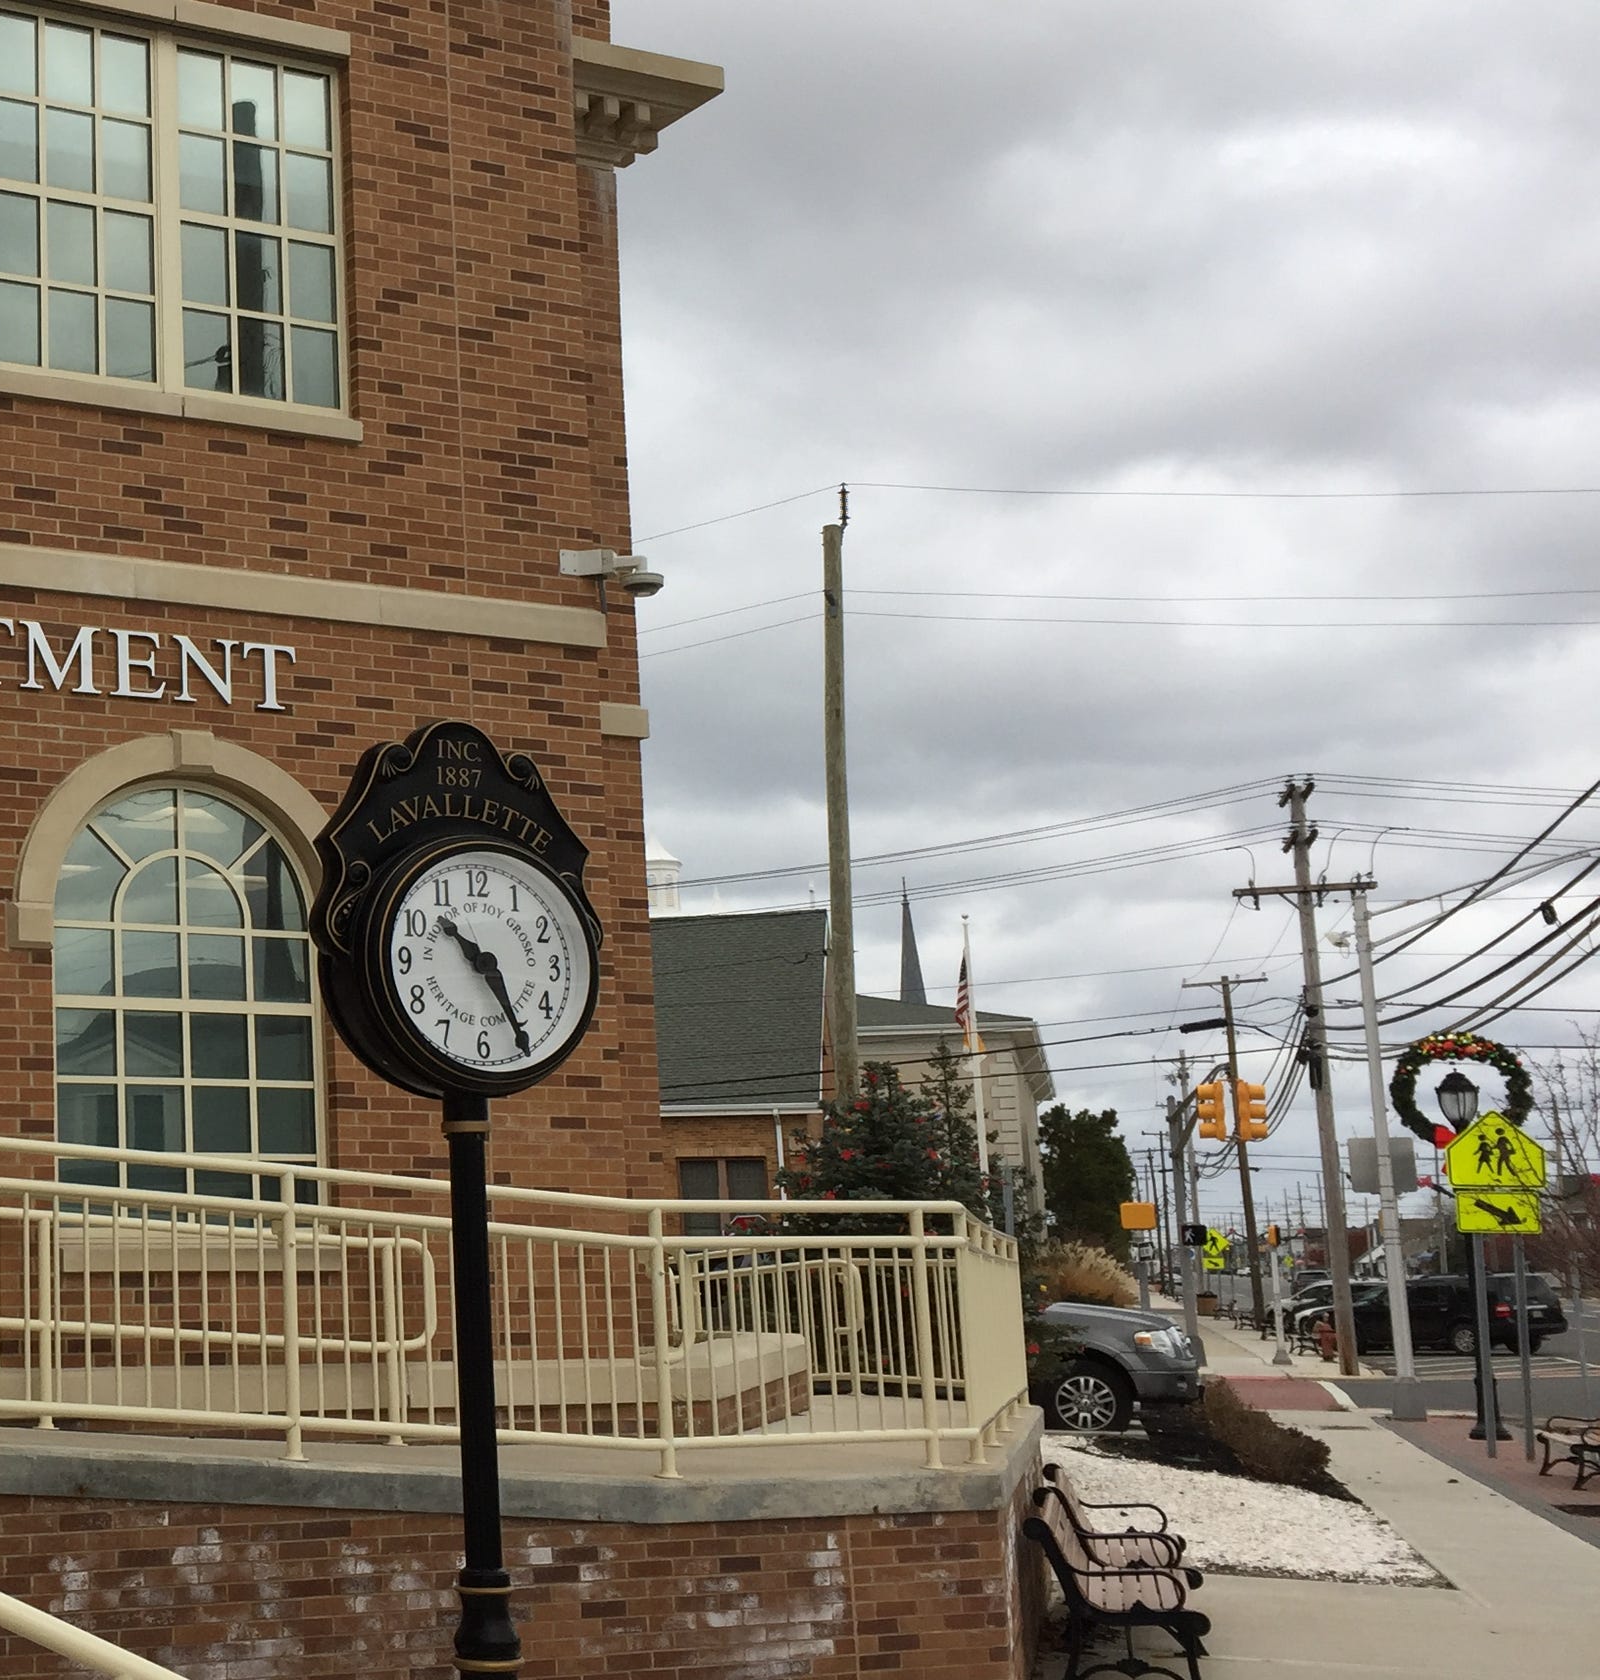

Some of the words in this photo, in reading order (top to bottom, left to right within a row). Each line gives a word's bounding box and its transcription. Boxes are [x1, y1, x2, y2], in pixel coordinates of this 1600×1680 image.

[436, 765, 482, 789] 1887
[366, 793, 553, 855] LAVALLETTE
[432, 878, 452, 907] 11
[465, 869, 490, 898] 12
[509, 884, 520, 912] 1
[463, 902, 478, 914] OF
[481, 903, 505, 919] JOY
[403, 908, 427, 938] 10
[426, 906, 461, 943] HOOR
[535, 915, 551, 944] 2
[423, 946, 433, 961] IN
[506, 917, 536, 968] GROSKO
[398, 946, 412, 975] 9
[549, 954, 561, 982] 3
[410, 984, 425, 1014] 8
[426, 975, 476, 1026] HERITAGE
[480, 979, 536, 1028] COMITTEE
[538, 990, 554, 1020] 4
[434, 1019, 451, 1049] 7
[477, 1030, 491, 1059] 6
